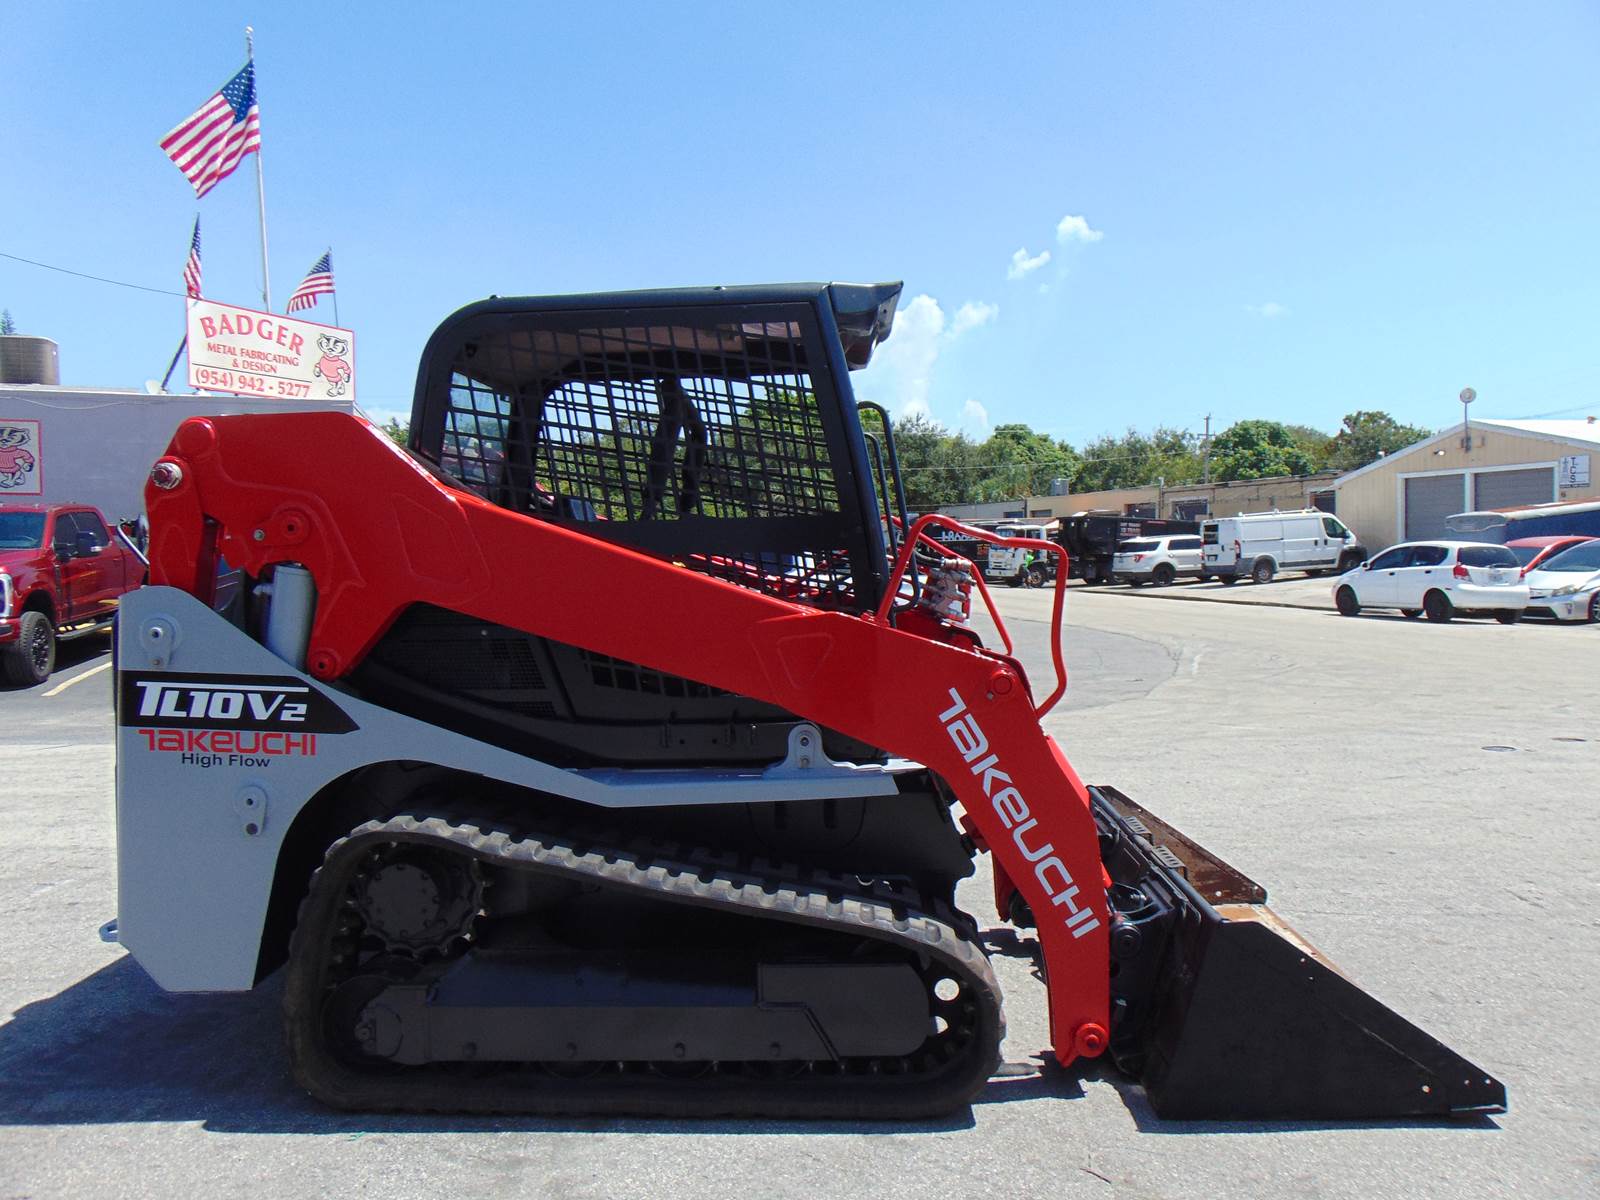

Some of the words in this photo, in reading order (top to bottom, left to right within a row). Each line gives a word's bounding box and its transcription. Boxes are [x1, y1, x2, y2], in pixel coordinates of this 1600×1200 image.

[200, 314, 304, 355] BADGER
[207, 342, 238, 357] METAL
[240, 347, 299, 367] FABRICATING
[232, 359, 239, 368] &
[242, 359, 277, 374] DESIGN
[195, 368, 234, 387] (954)
[238, 374, 265, 391] 942
[277, 382, 311, 398] 5277
[136, 681, 309, 721] TL10V2
[181, 752, 222, 768] High
[228, 754, 271, 767] Flow
